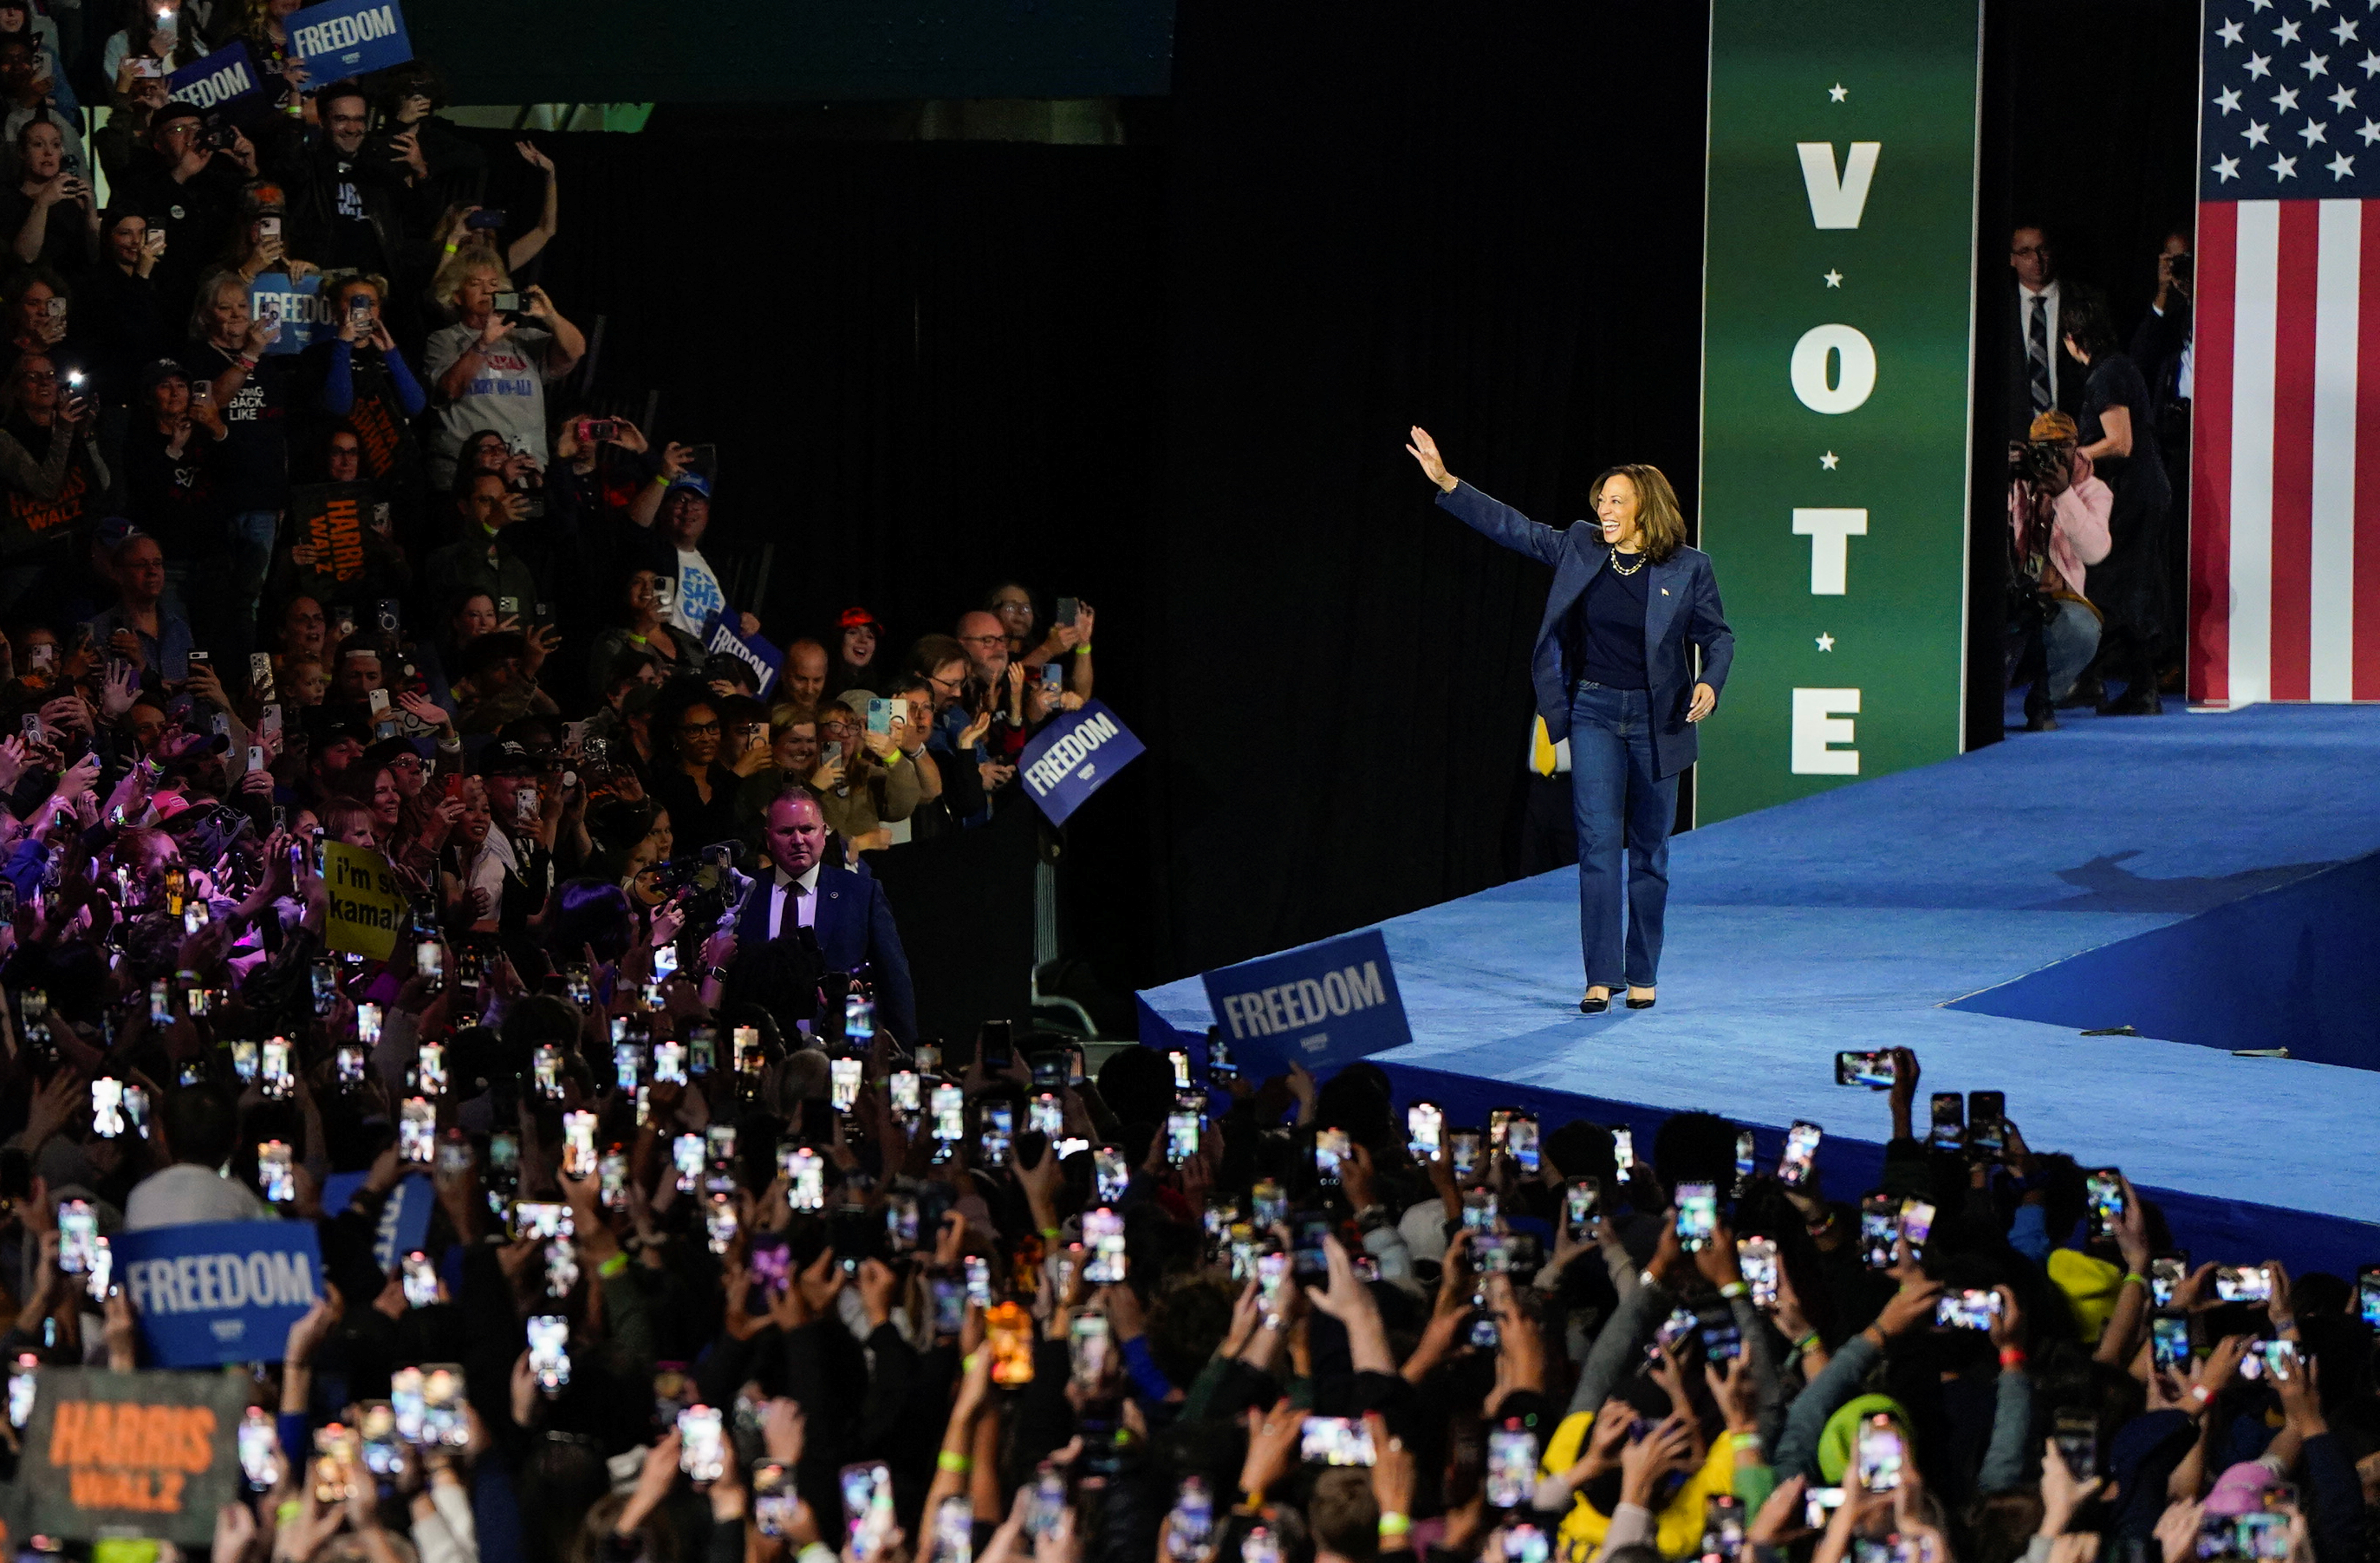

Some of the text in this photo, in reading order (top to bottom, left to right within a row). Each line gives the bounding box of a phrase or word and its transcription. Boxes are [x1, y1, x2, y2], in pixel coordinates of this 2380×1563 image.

[293, 5, 396, 59] FREEDOM
[229, 408, 258, 420] LIKE
[1790, 141, 1882, 775] VOTE
[27, 499, 83, 531] WALZ
[327, 500, 366, 582] HARRIS
[1024, 712, 1119, 797] FREEDOM
[337, 857, 370, 890] i'm
[1223, 960, 1386, 1039] FREEDOM
[126, 1250, 313, 1315] FREEDOM
